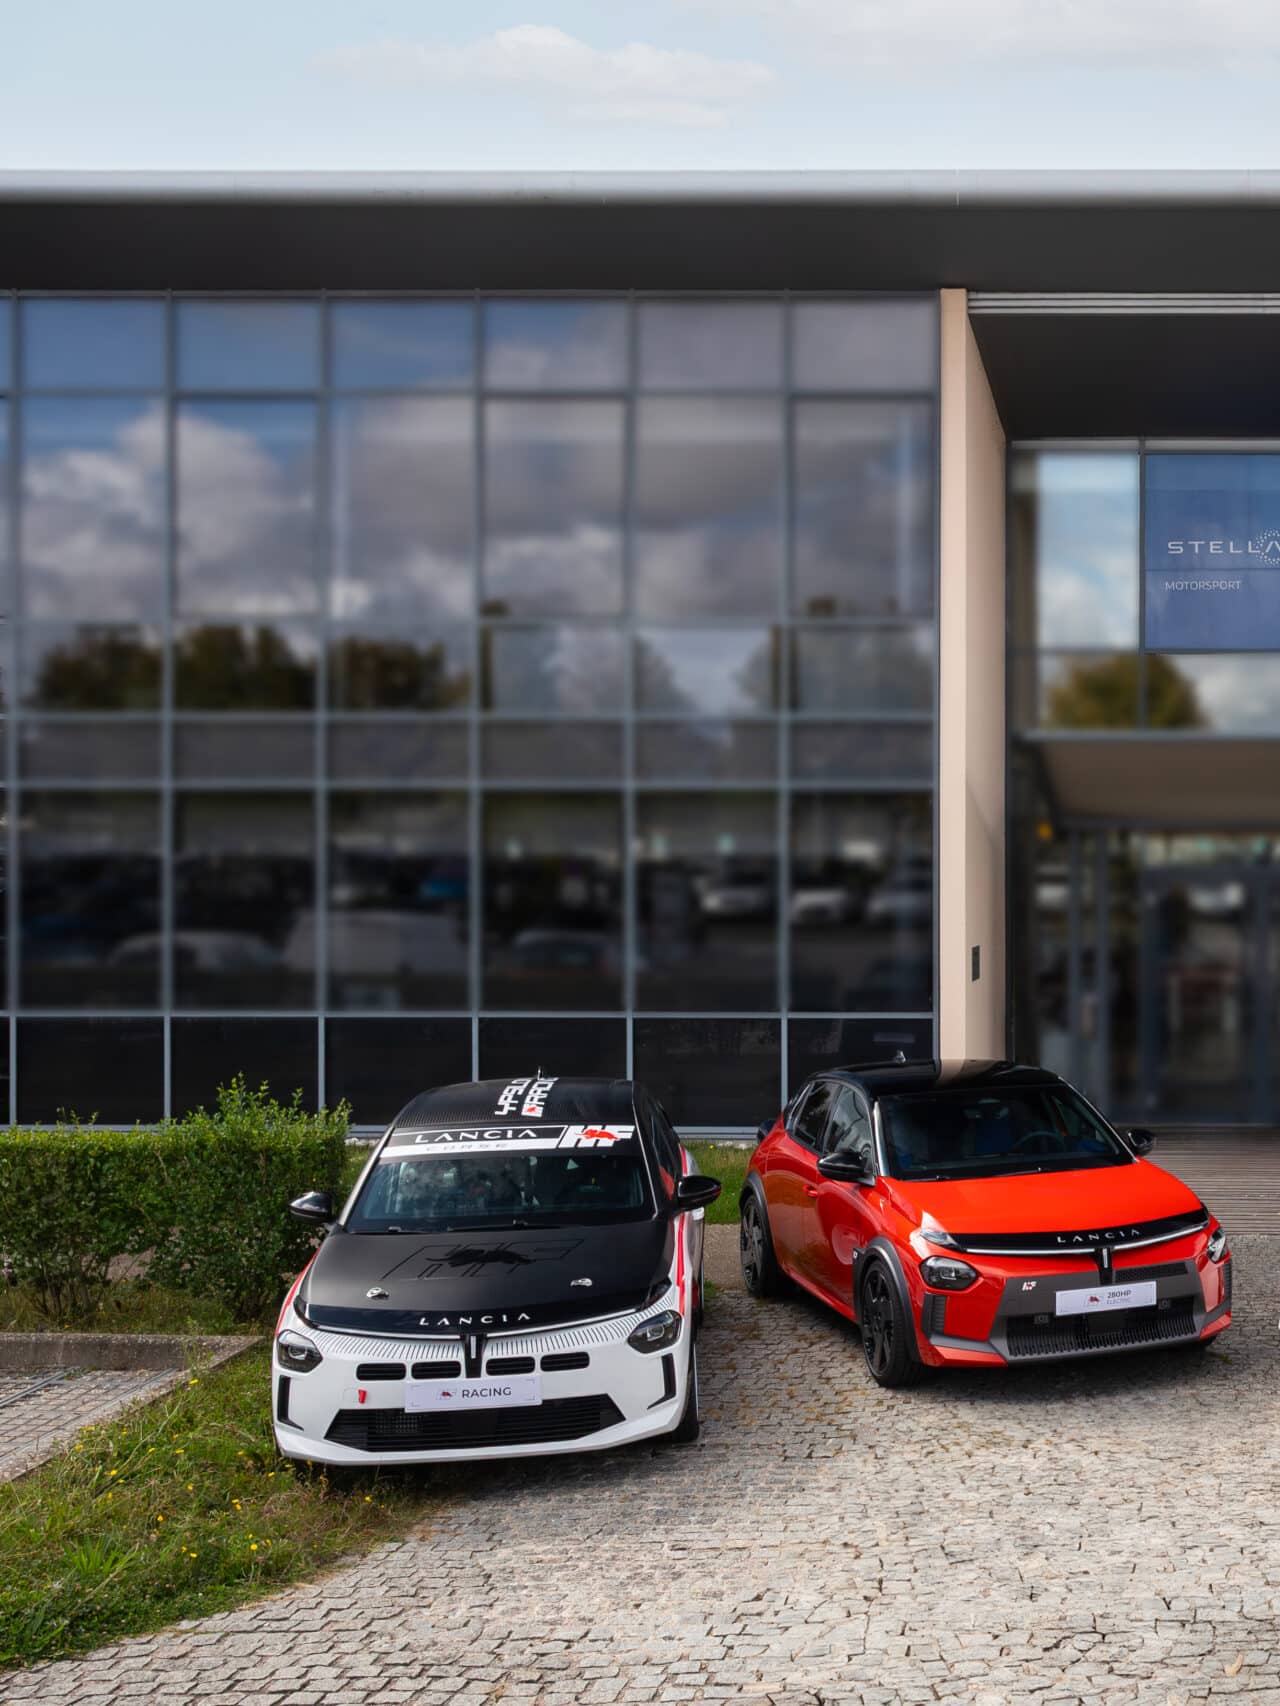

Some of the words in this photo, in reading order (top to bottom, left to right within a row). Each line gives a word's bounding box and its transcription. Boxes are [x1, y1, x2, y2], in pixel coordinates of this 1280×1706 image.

[1165, 580, 1241, 591] MOTORSPORT
[415, 1129, 537, 1143] LANCIA
[558, 1125, 635, 1148] HF
[1057, 1229, 1141, 1243] LANCIA
[419, 1313, 530, 1326] LANCIA
[462, 1387, 512, 1398] RACING
